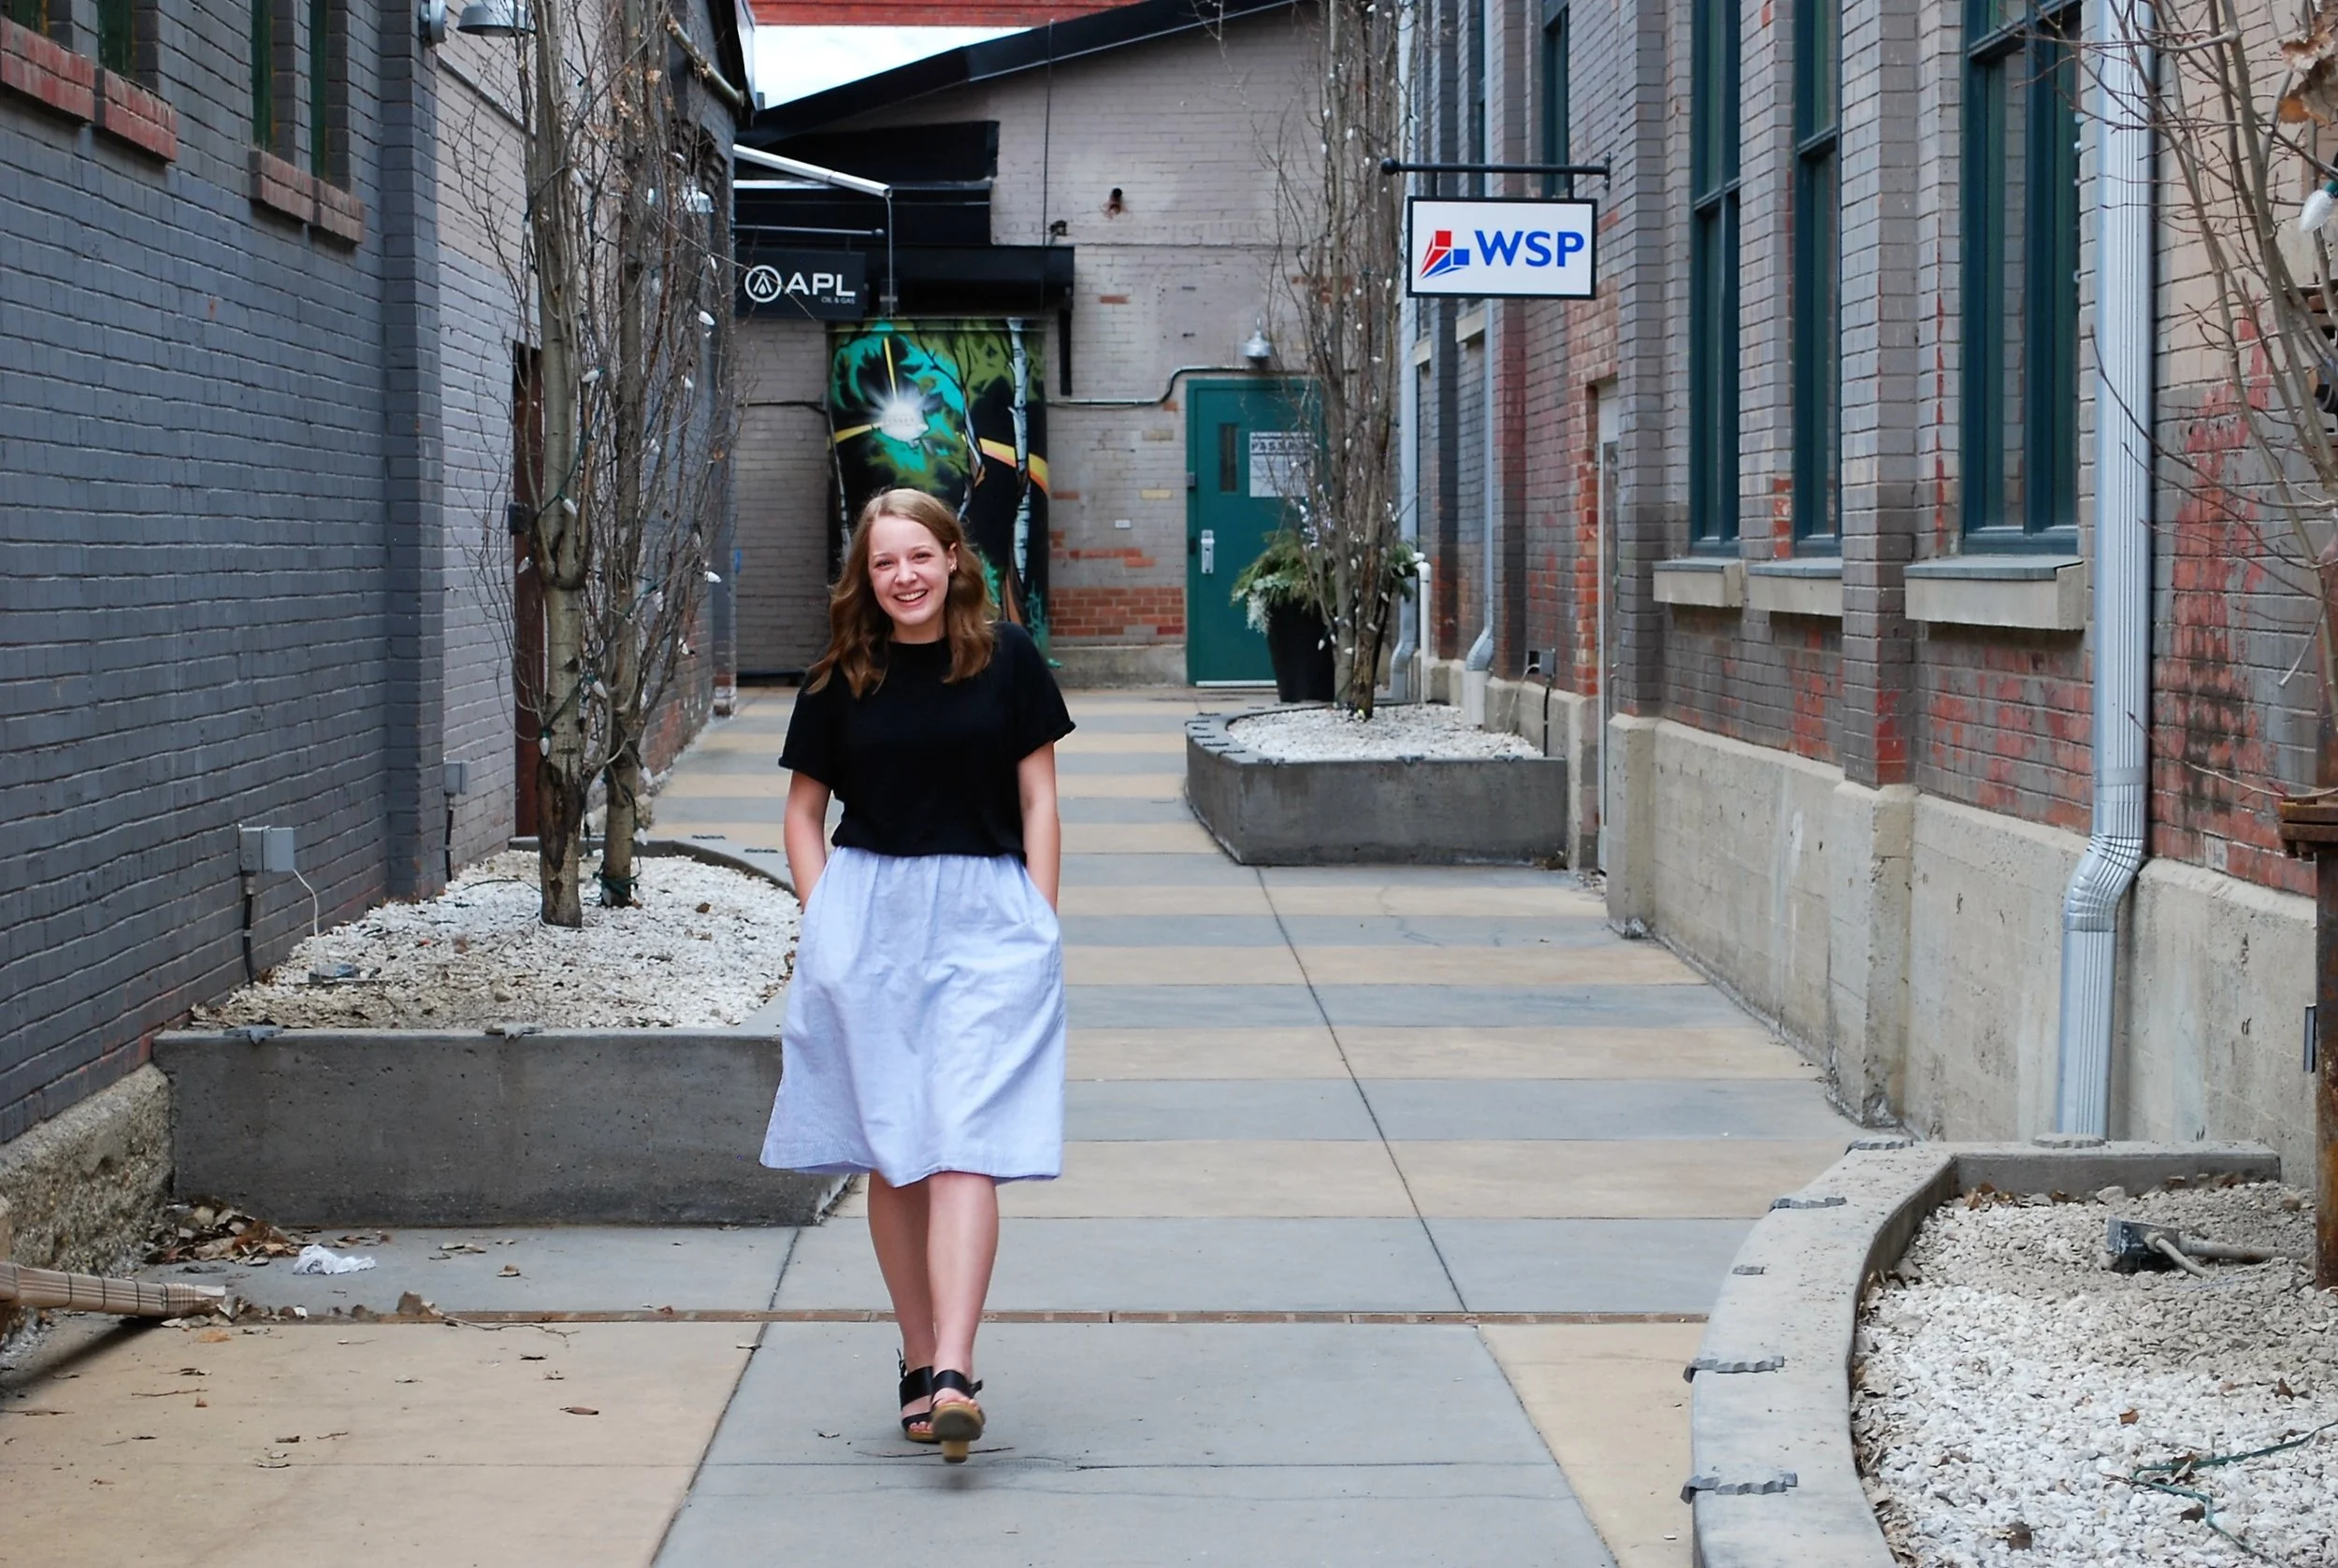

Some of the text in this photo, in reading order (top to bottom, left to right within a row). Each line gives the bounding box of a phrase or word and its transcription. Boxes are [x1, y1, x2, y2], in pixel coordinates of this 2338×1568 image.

[1474, 230, 1585, 267] WSP
[786, 272, 856, 296] APL
[821, 295, 832, 304] OIL
[841, 296, 855, 305] GAS
